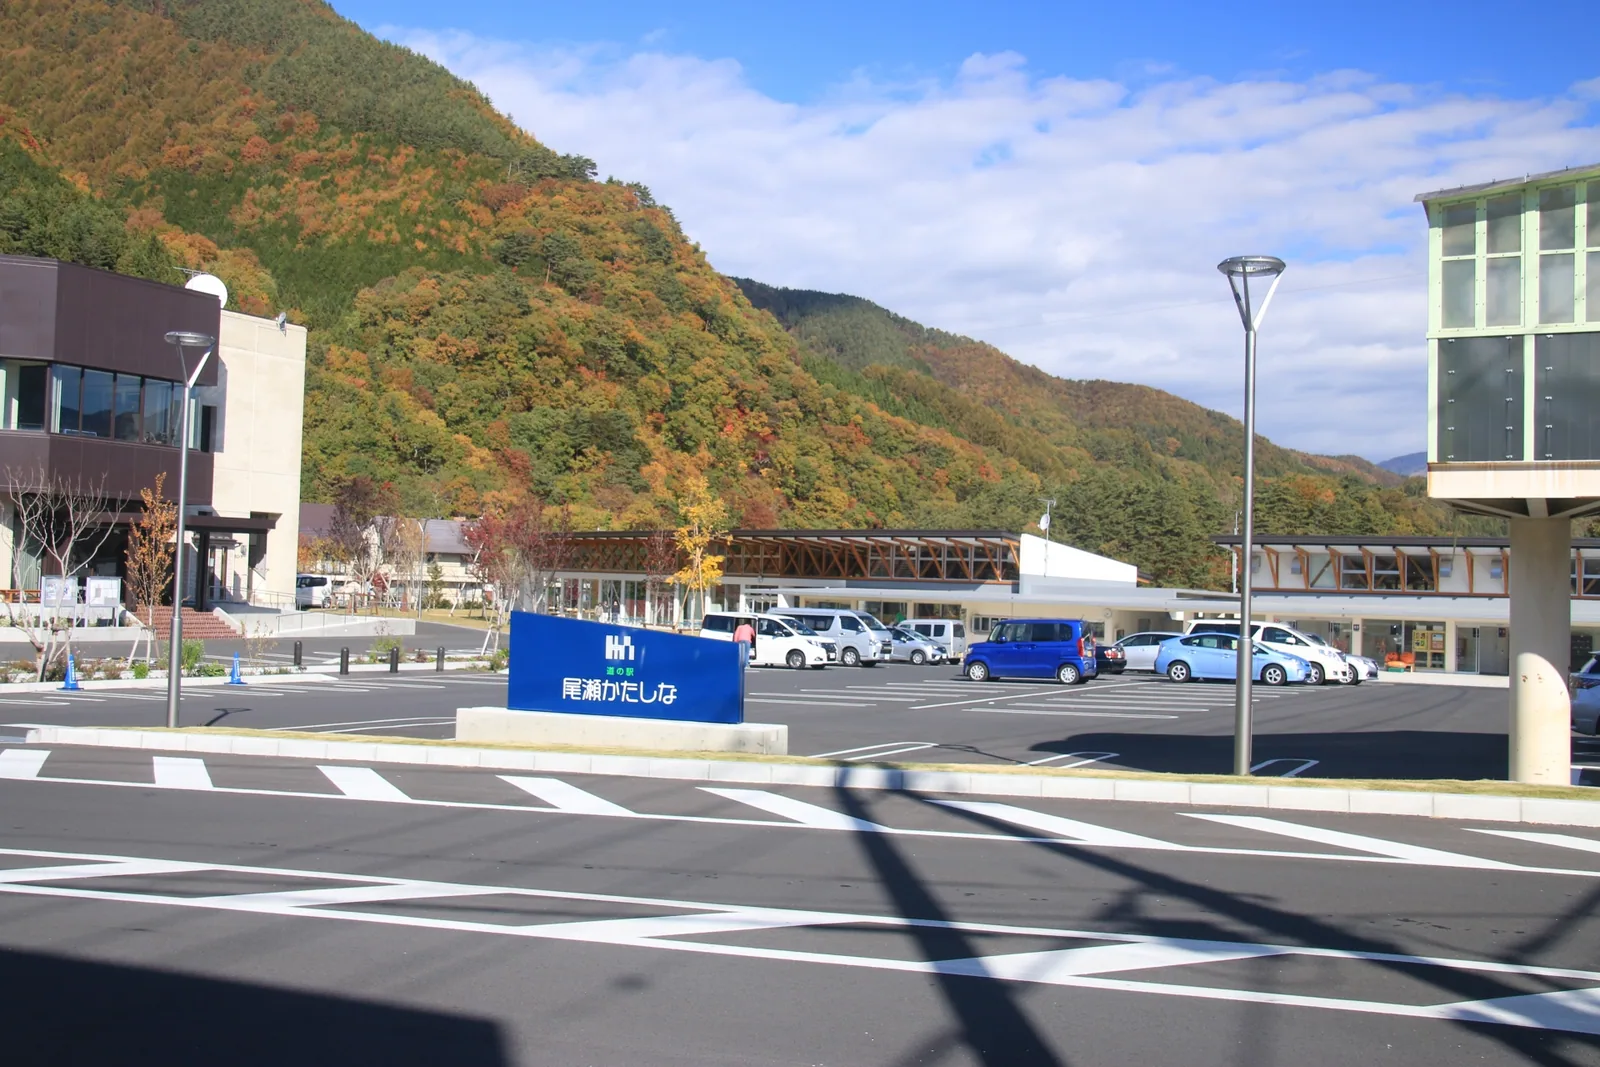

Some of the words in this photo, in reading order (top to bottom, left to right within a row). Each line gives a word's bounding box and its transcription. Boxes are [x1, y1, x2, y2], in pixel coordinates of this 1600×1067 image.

[606, 666, 634, 677] 道の駅
[562, 677, 677, 705] 尾瀬かたしな
